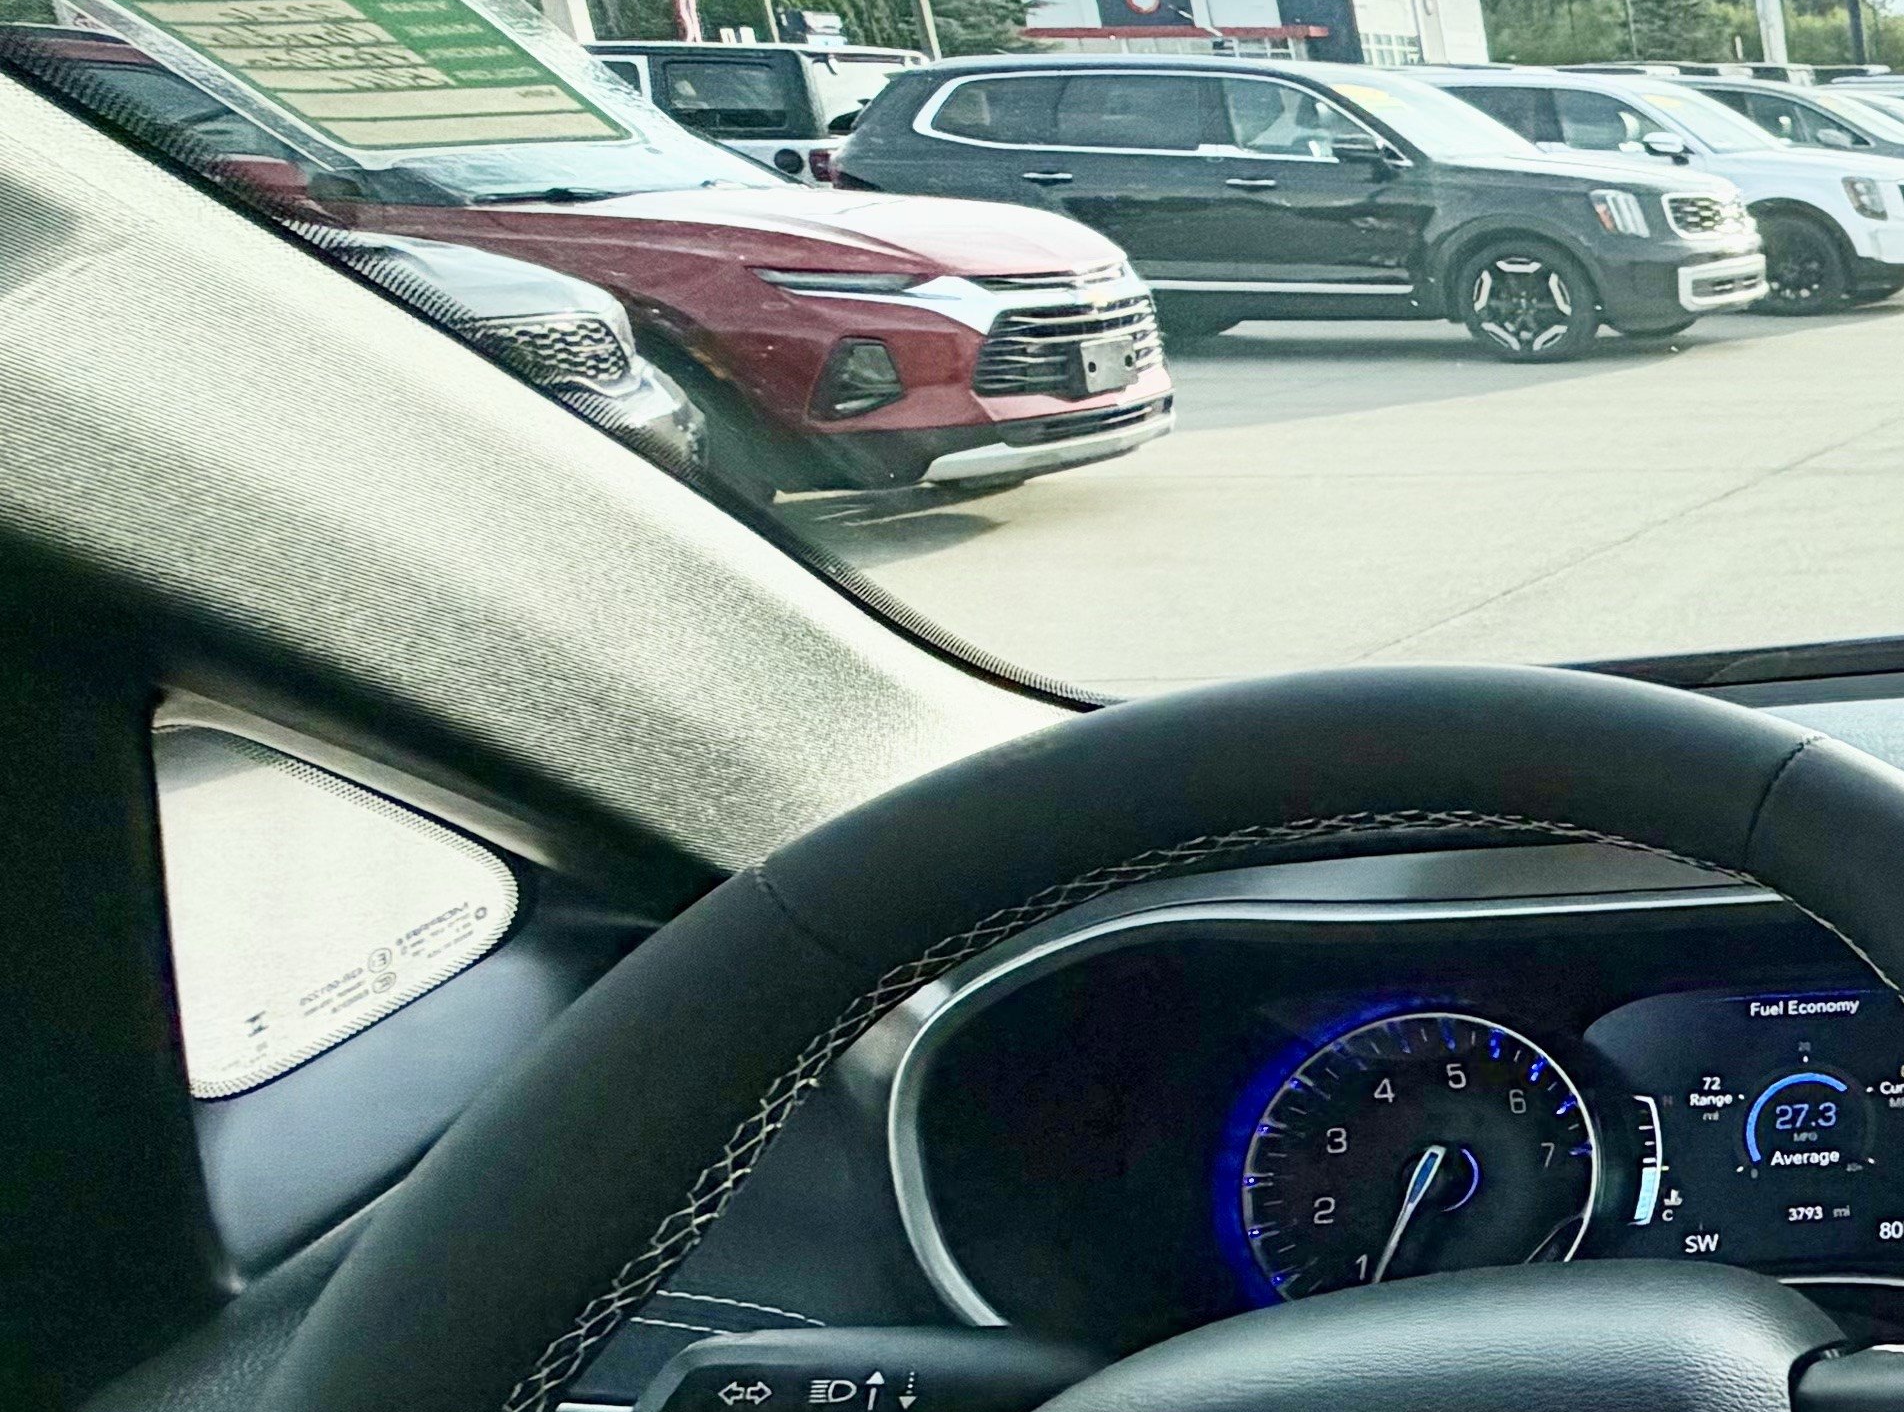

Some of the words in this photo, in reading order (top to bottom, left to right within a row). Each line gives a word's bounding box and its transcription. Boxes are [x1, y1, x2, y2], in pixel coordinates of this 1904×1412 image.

[1750, 1001, 1785, 1017] Fuel
[1788, 998, 1860, 1015] Economy
[1446, 1063, 1467, 1089] 5
[1702, 1077, 1721, 1091] 72
[1373, 1078, 1395, 1103] 4
[1509, 1088, 1527, 1114] 6
[1689, 1093, 1733, 1107] Range
[1774, 1101, 1838, 1130] 27.3
[1326, 1127, 1347, 1154] 3
[1540, 1142, 1555, 1168] 7
[1771, 1150, 1840, 1167] Average
[1313, 1196, 1336, 1224] 2
[1788, 1206, 1824, 1221] 3793
[1684, 1233, 1719, 1253] SW
[1355, 1254, 1368, 1280] 1
